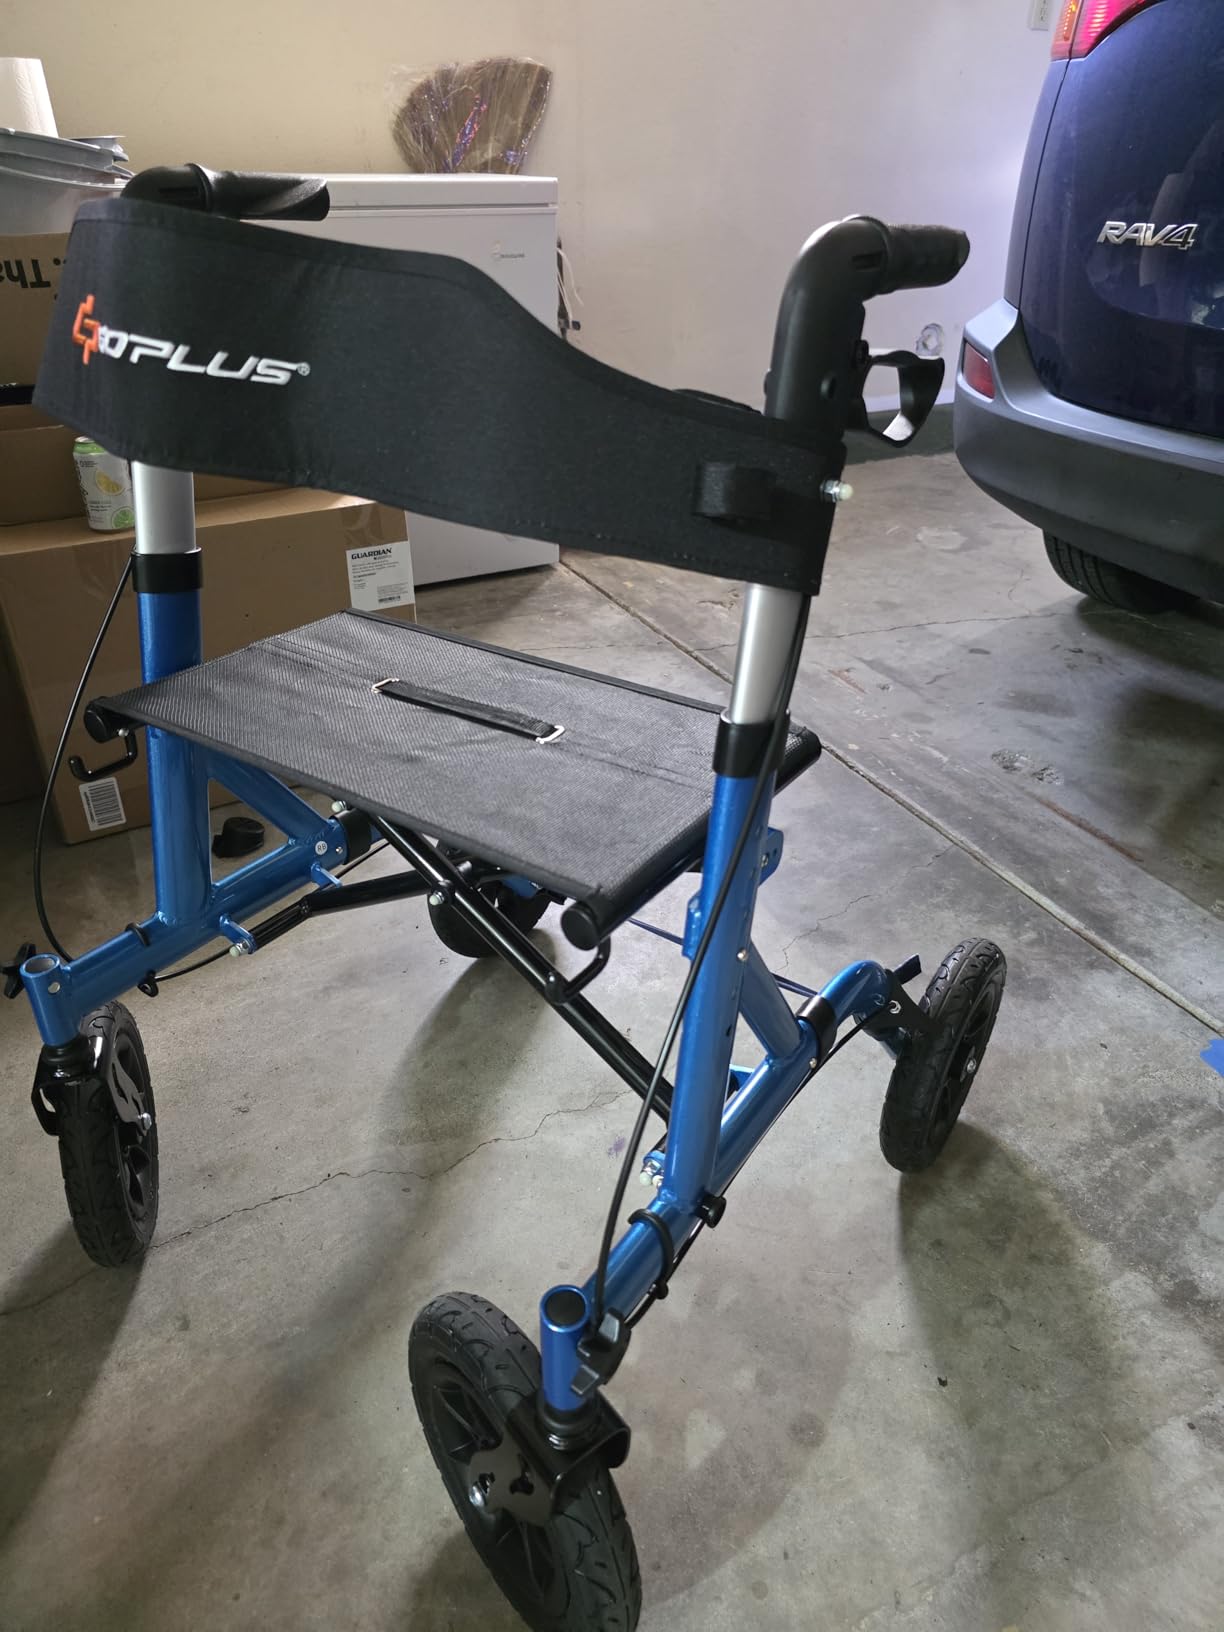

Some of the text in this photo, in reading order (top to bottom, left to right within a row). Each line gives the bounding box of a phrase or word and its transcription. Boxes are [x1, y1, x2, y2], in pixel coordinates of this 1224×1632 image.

[1097, 221, 1198, 250] RAV4
[0, 258, 51, 288] Th
[351, 548, 392, 560] GUARDIAN
